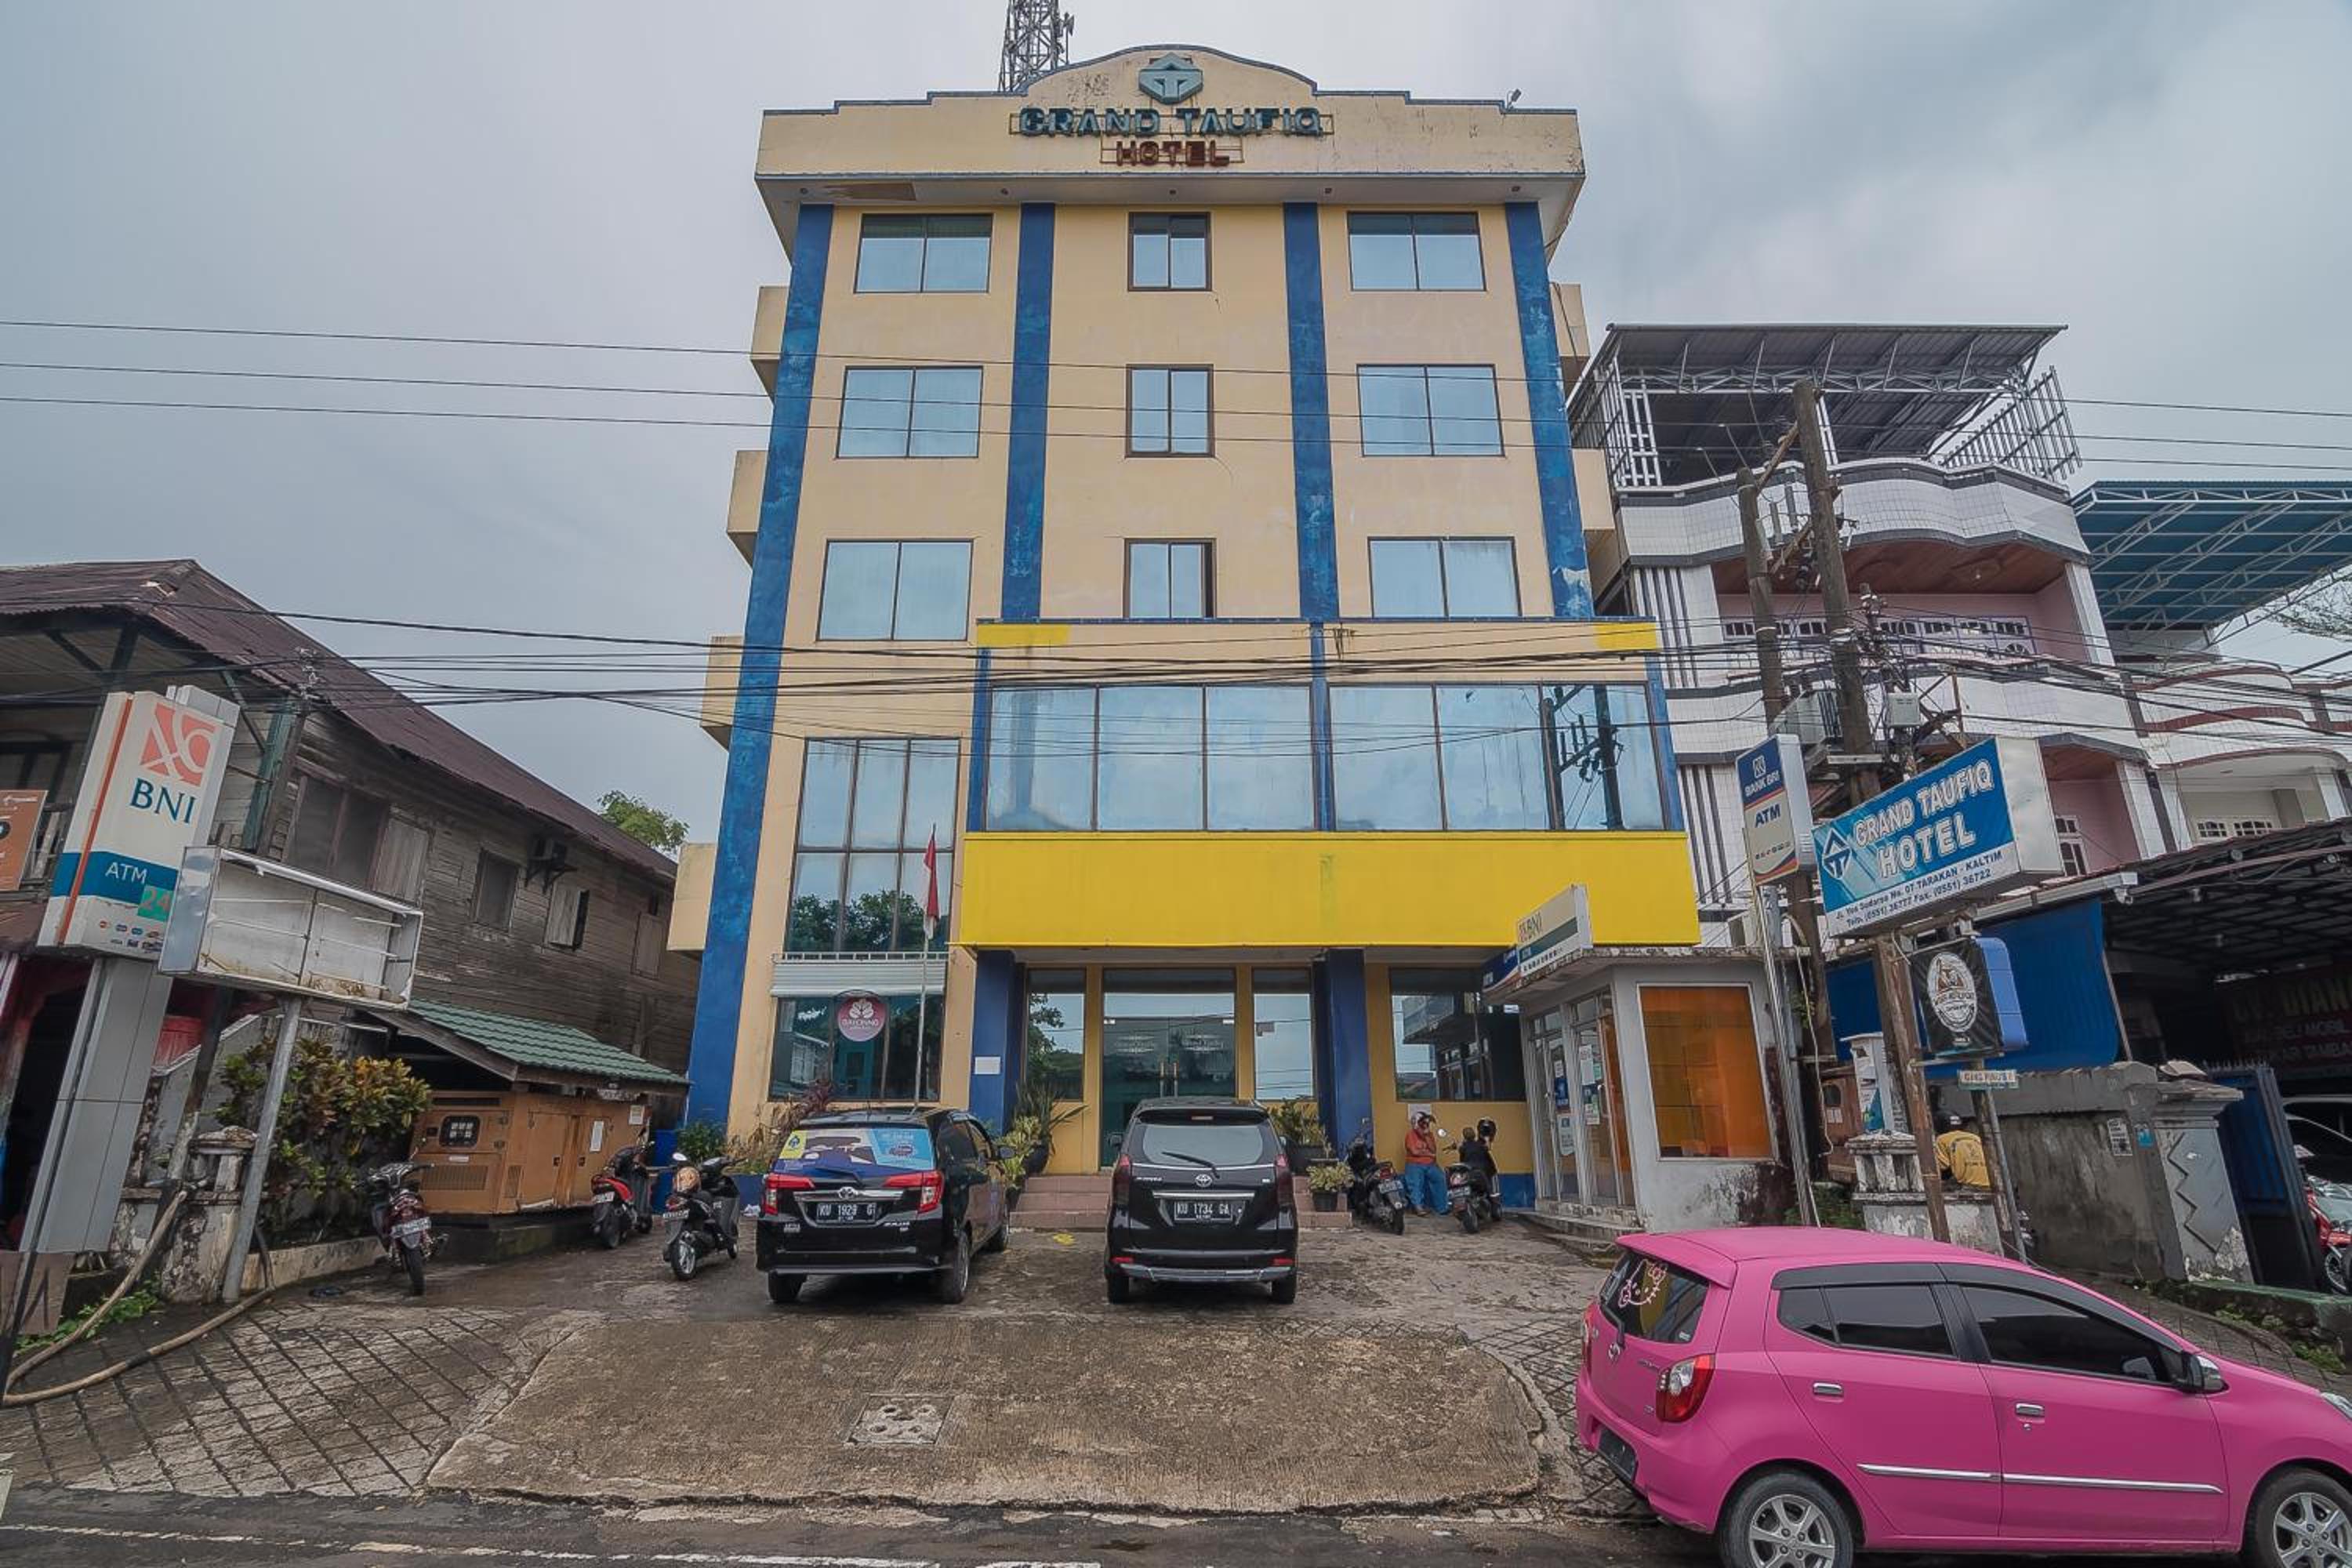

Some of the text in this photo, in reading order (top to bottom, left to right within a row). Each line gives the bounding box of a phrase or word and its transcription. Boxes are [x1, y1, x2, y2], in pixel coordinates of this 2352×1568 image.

[1020, 107, 1323, 136] GRAND TAUFIQ
[1116, 140, 1230, 167] HOTEL
[1744, 775, 1767, 797] BANK
[129, 778, 198, 825] BNI
[1755, 802, 1781, 829] ATM
[1853, 758, 1995, 850] GRAND TAUFIQ
[1878, 812, 1976, 880] HOTEL
[104, 861, 147, 885] ATM
[1916, 866, 1958, 889] TARAKAN
[1965, 850, 2003, 871] KALTIM
